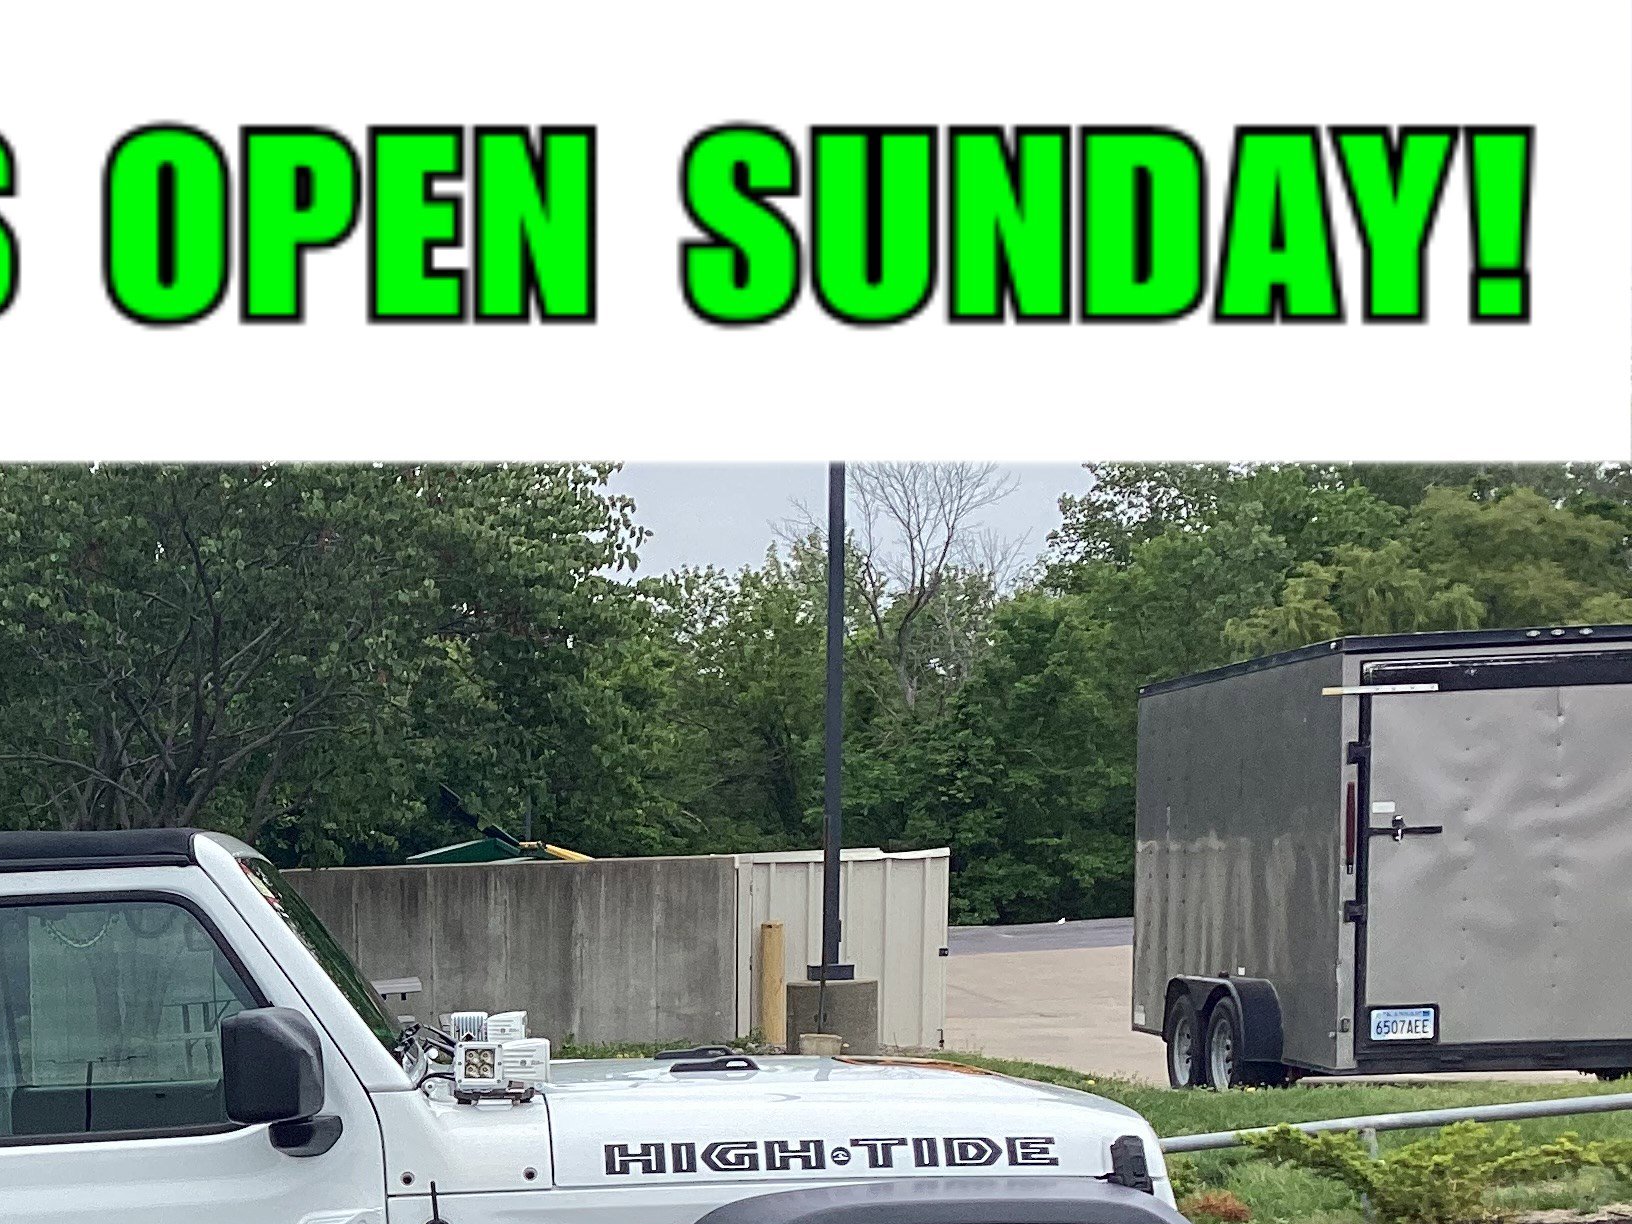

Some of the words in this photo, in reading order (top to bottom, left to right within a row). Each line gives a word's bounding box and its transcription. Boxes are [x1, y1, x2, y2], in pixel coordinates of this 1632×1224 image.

[1375, 1019, 1430, 1035] 6507AEE
[604, 1139, 827, 1175] HIGH
[849, 1137, 1060, 1168] TIDE
